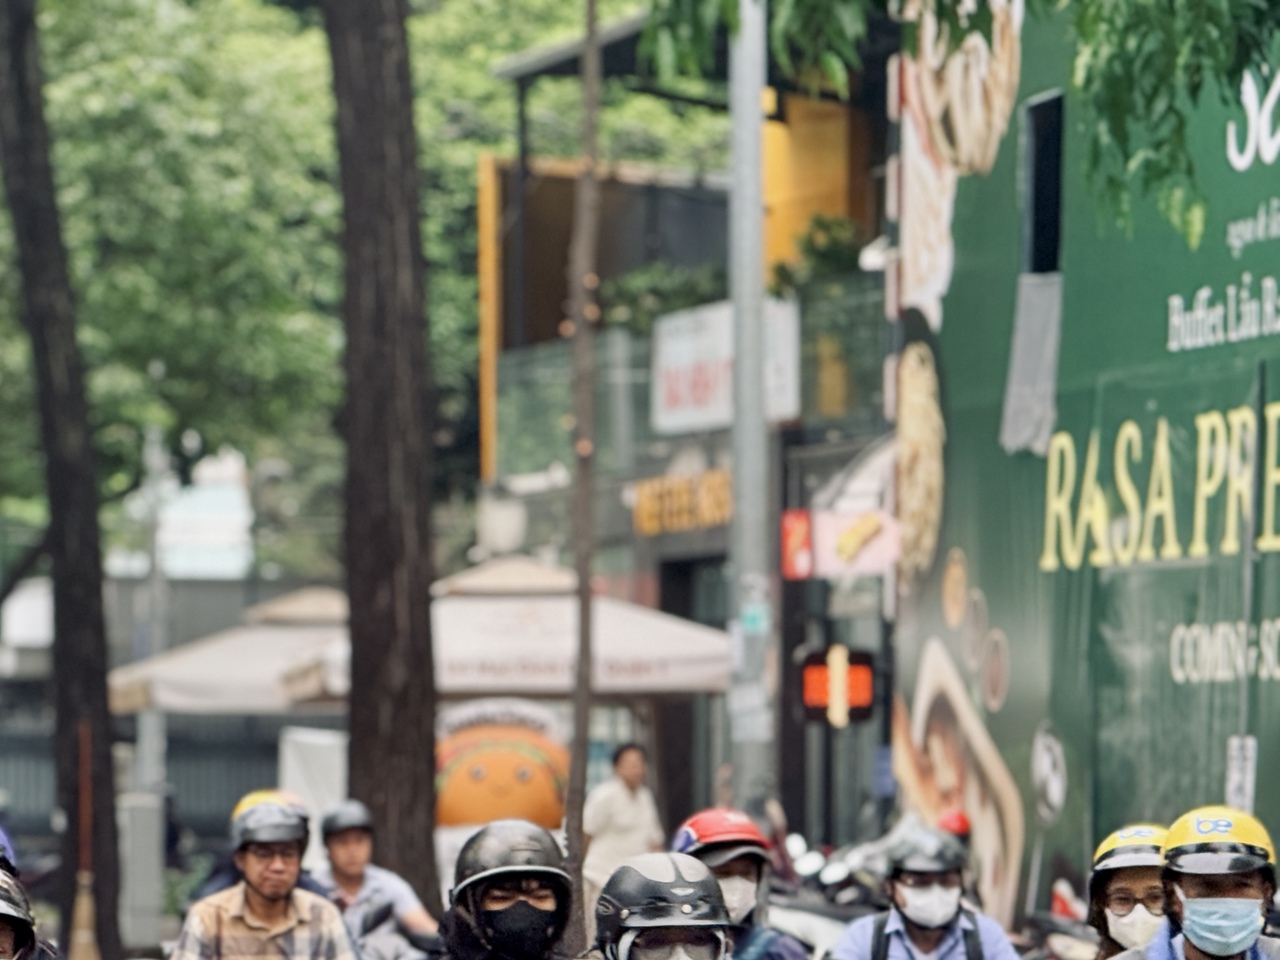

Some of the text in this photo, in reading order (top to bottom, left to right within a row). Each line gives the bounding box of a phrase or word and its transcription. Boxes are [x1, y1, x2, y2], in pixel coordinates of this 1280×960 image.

[1166, 286, 1225, 353] Buffet
[1261, 275, 1280, 337] R
[1039, 416, 1183, 573] RASA
[1196, 816, 1233, 835] be
